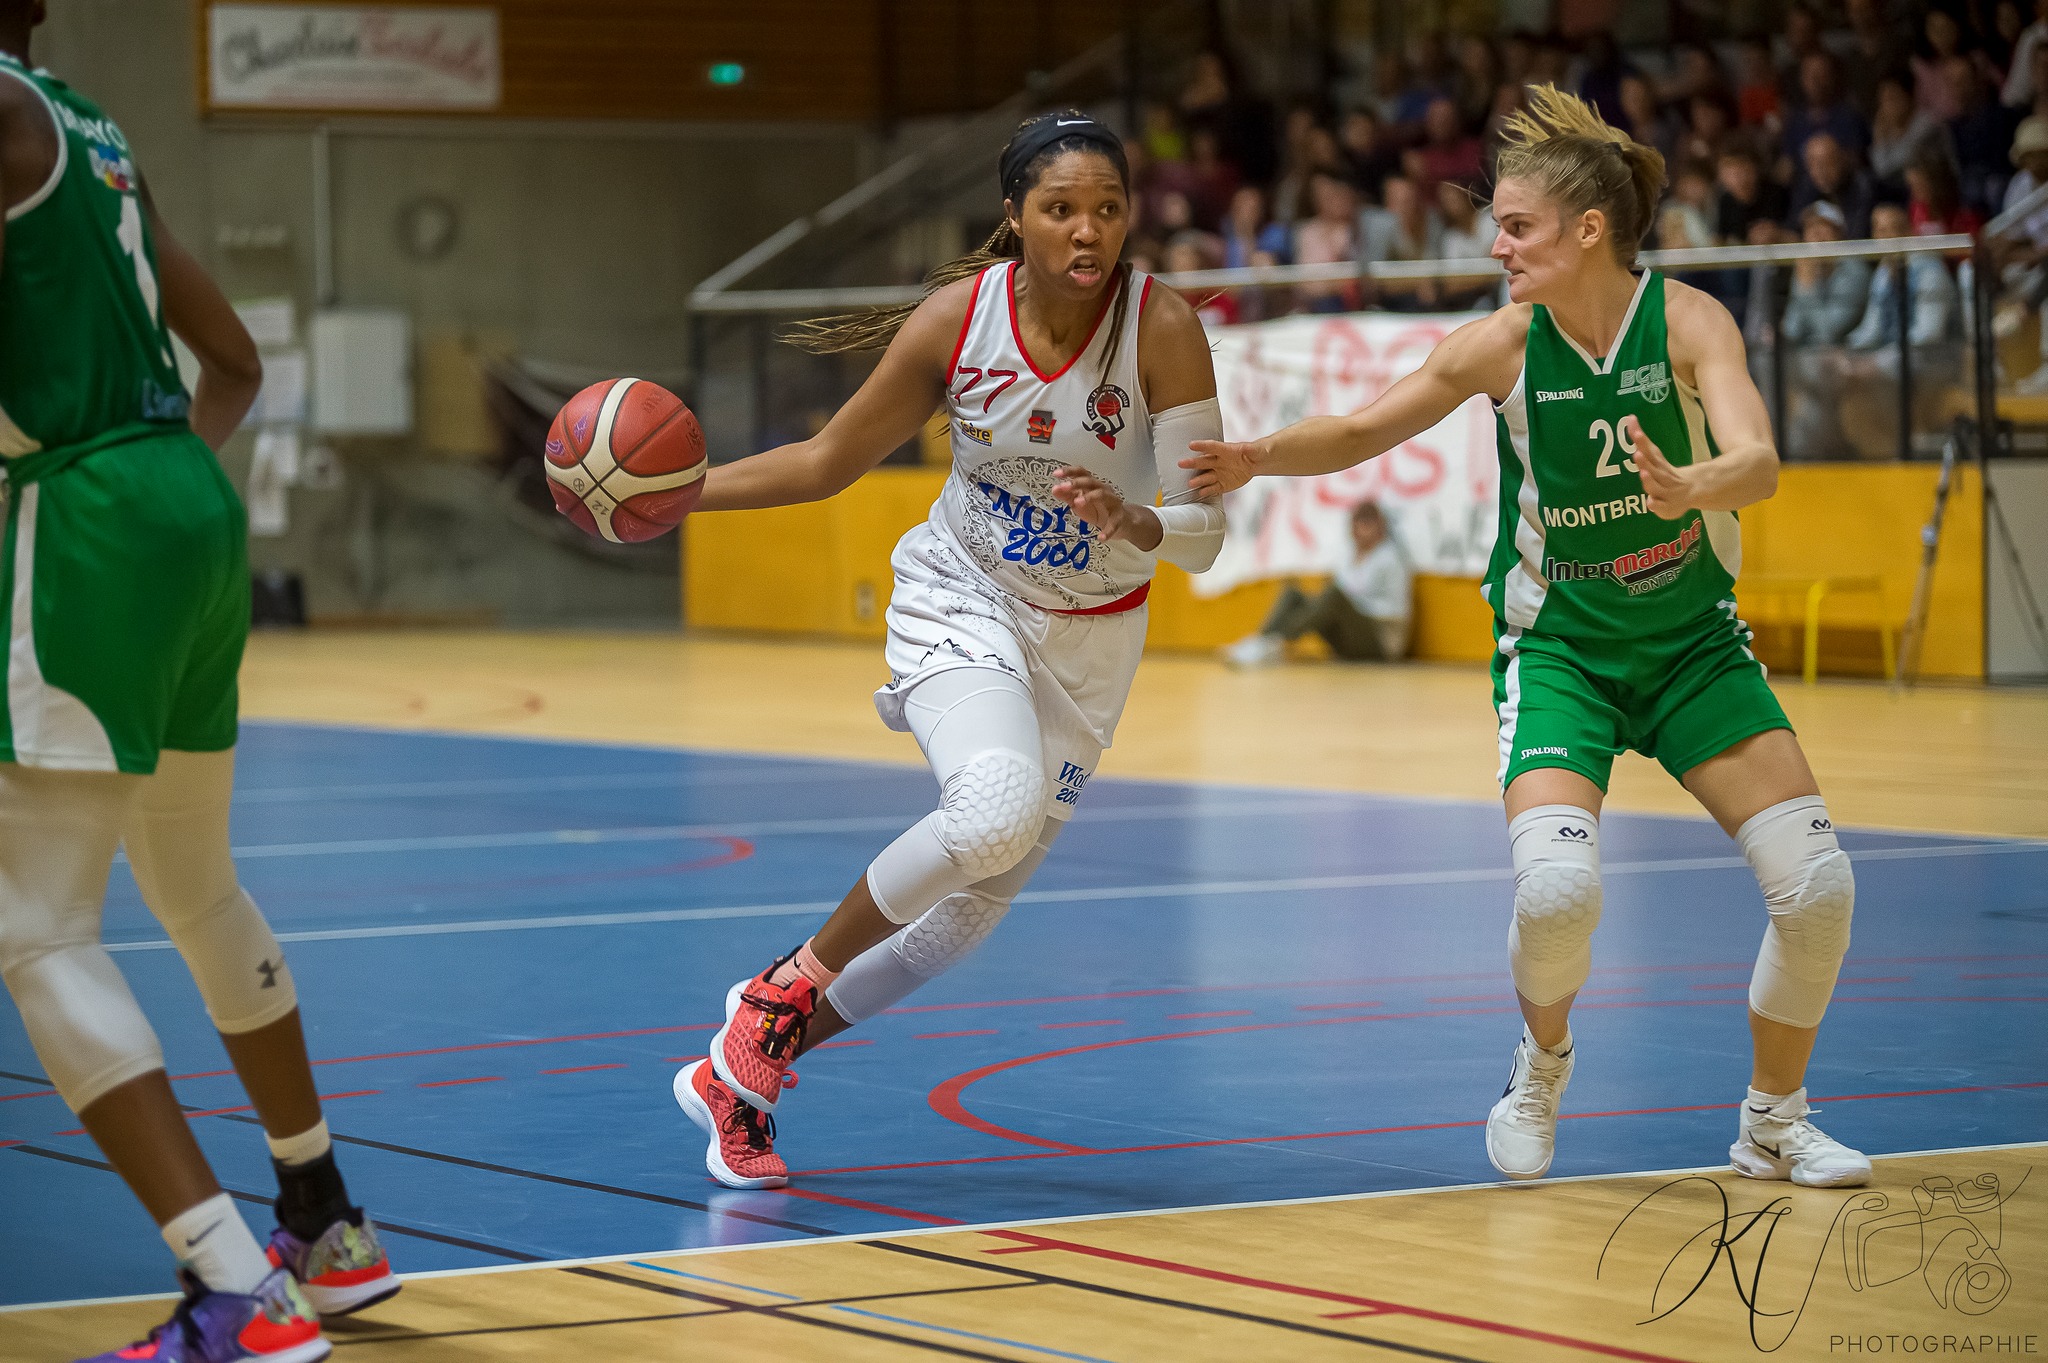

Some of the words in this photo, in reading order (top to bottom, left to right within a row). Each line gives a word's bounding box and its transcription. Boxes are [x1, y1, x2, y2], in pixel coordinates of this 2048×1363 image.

[954, 365, 1019, 414] 77
[1536, 387, 1584, 402] SPALDING
[961, 421, 991, 441] sère
[1543, 493, 1648, 529] MONTBRI
[1002, 528, 1090, 571] 2000
[1521, 746, 1568, 760] SPALDING
[1058, 760, 1091, 788] Wor
